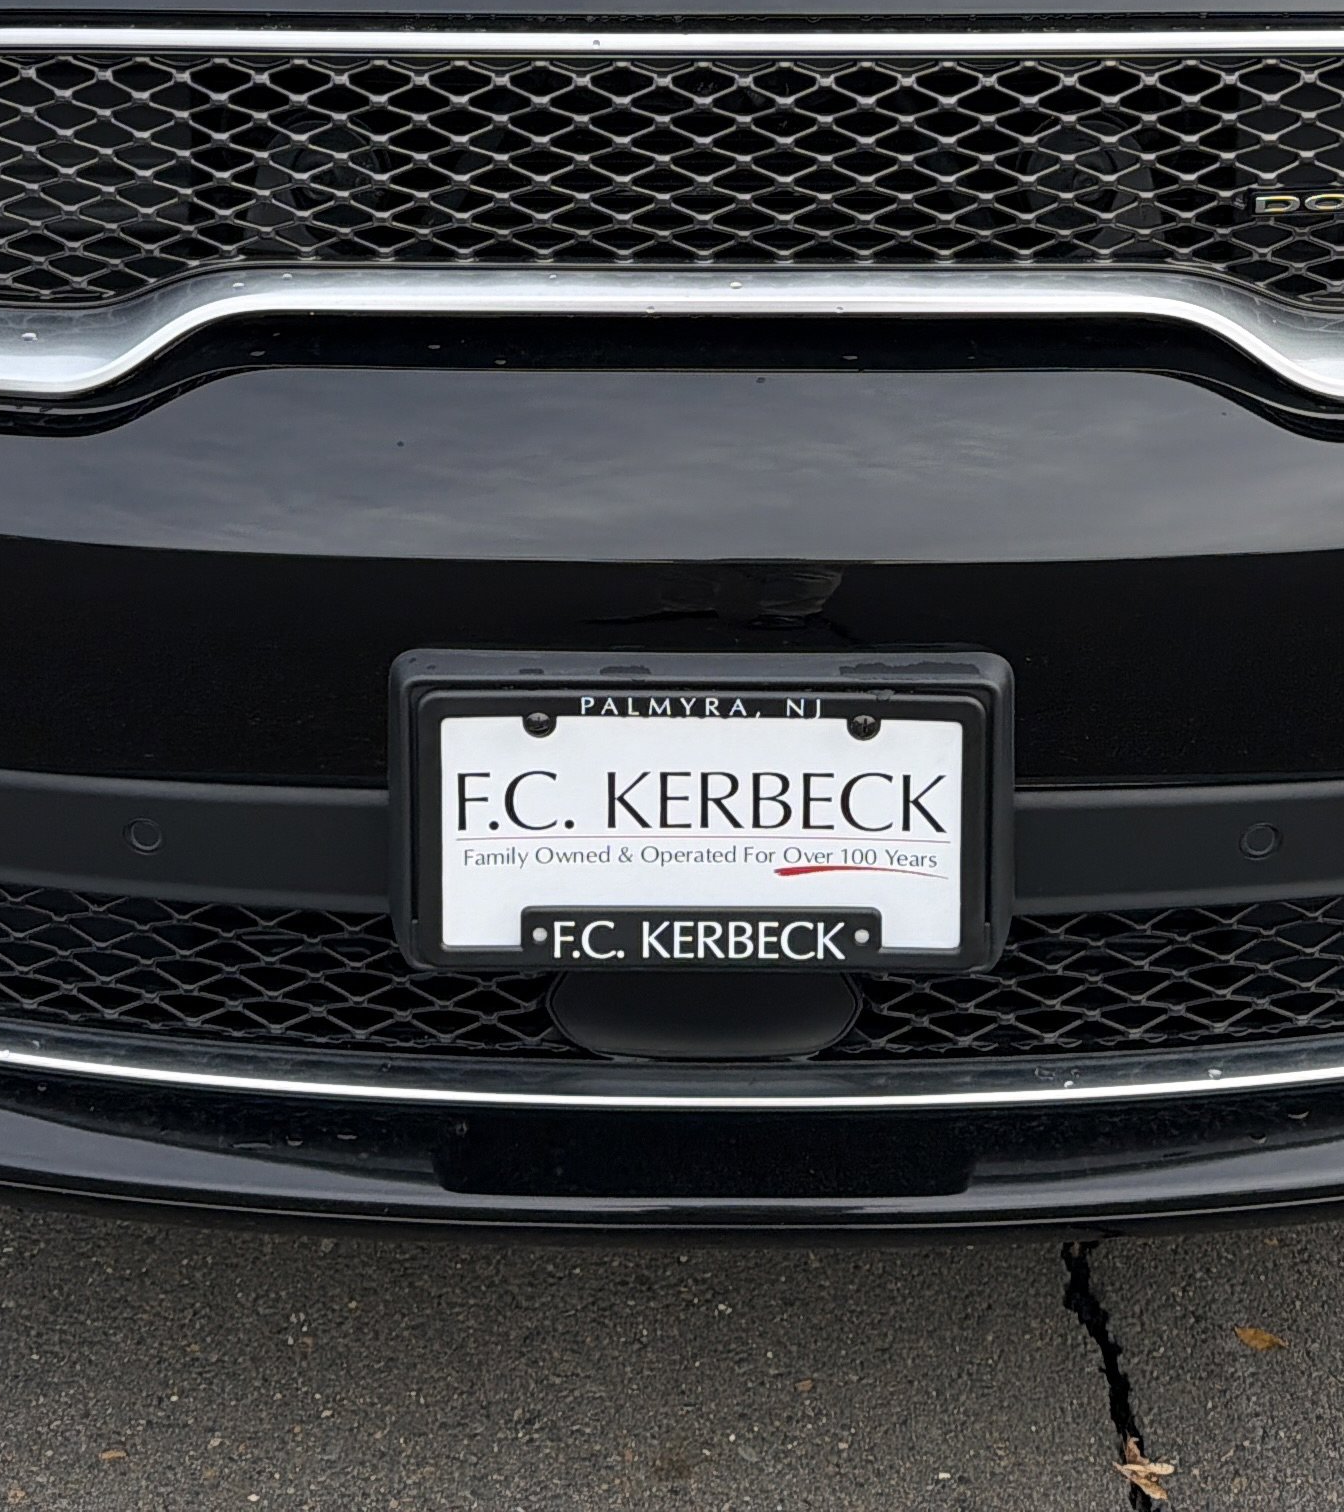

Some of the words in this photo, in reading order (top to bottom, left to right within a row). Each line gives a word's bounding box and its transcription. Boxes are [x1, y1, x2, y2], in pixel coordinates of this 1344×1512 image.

[580, 696, 762, 719] PALMYRA,
[786, 698, 823, 720] NJ
[457, 770, 575, 831] F.C.
[607, 771, 947, 834] KERBECK
[464, 847, 529, 869] Family
[535, 845, 611, 865] Owned
[618, 846, 634, 864] &
[641, 844, 737, 867] Operated
[743, 846, 776, 864] For
[783, 846, 833, 865] Over
[841, 848, 877, 866] 100
[885, 849, 938, 869] Years
[553, 921, 625, 960] F.C.
[642, 920, 846, 961] KERBECK
